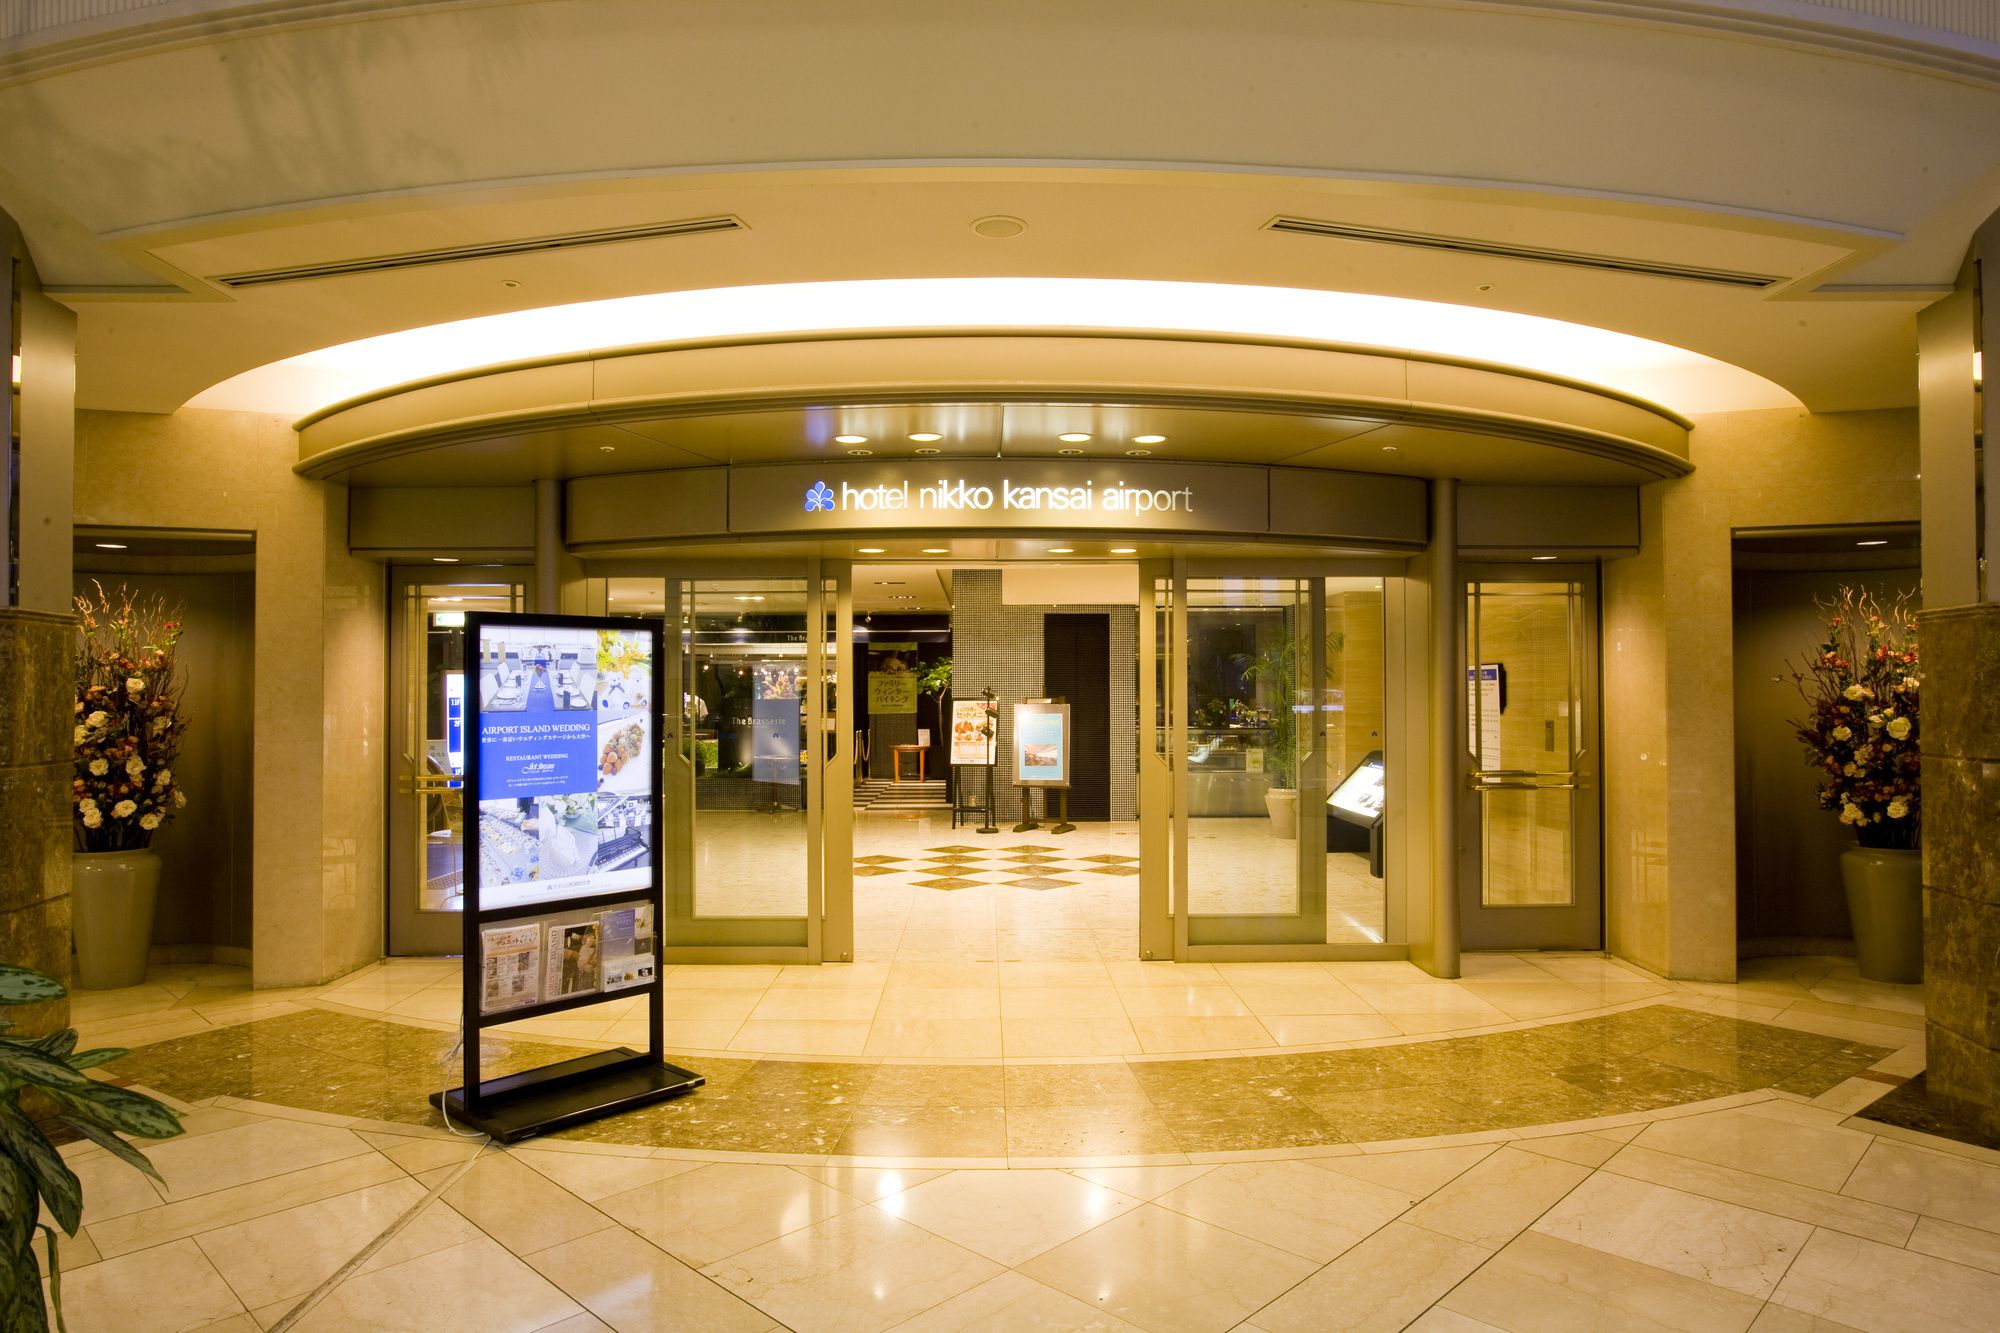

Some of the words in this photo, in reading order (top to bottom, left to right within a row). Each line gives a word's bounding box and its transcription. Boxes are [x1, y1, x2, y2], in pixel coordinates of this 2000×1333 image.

[842, 480, 908, 510] hotel
[919, 479, 994, 510] nikko
[1003, 479, 1092, 510] kansai
[1102, 480, 1194, 517] airport
[732, 717, 746, 725] The
[747, 716, 787, 726] Brasserie
[482, 726, 519, 735] AIRPORT
[520, 725, 550, 734] ISLAND
[551, 723, 590, 732] WEDDING
